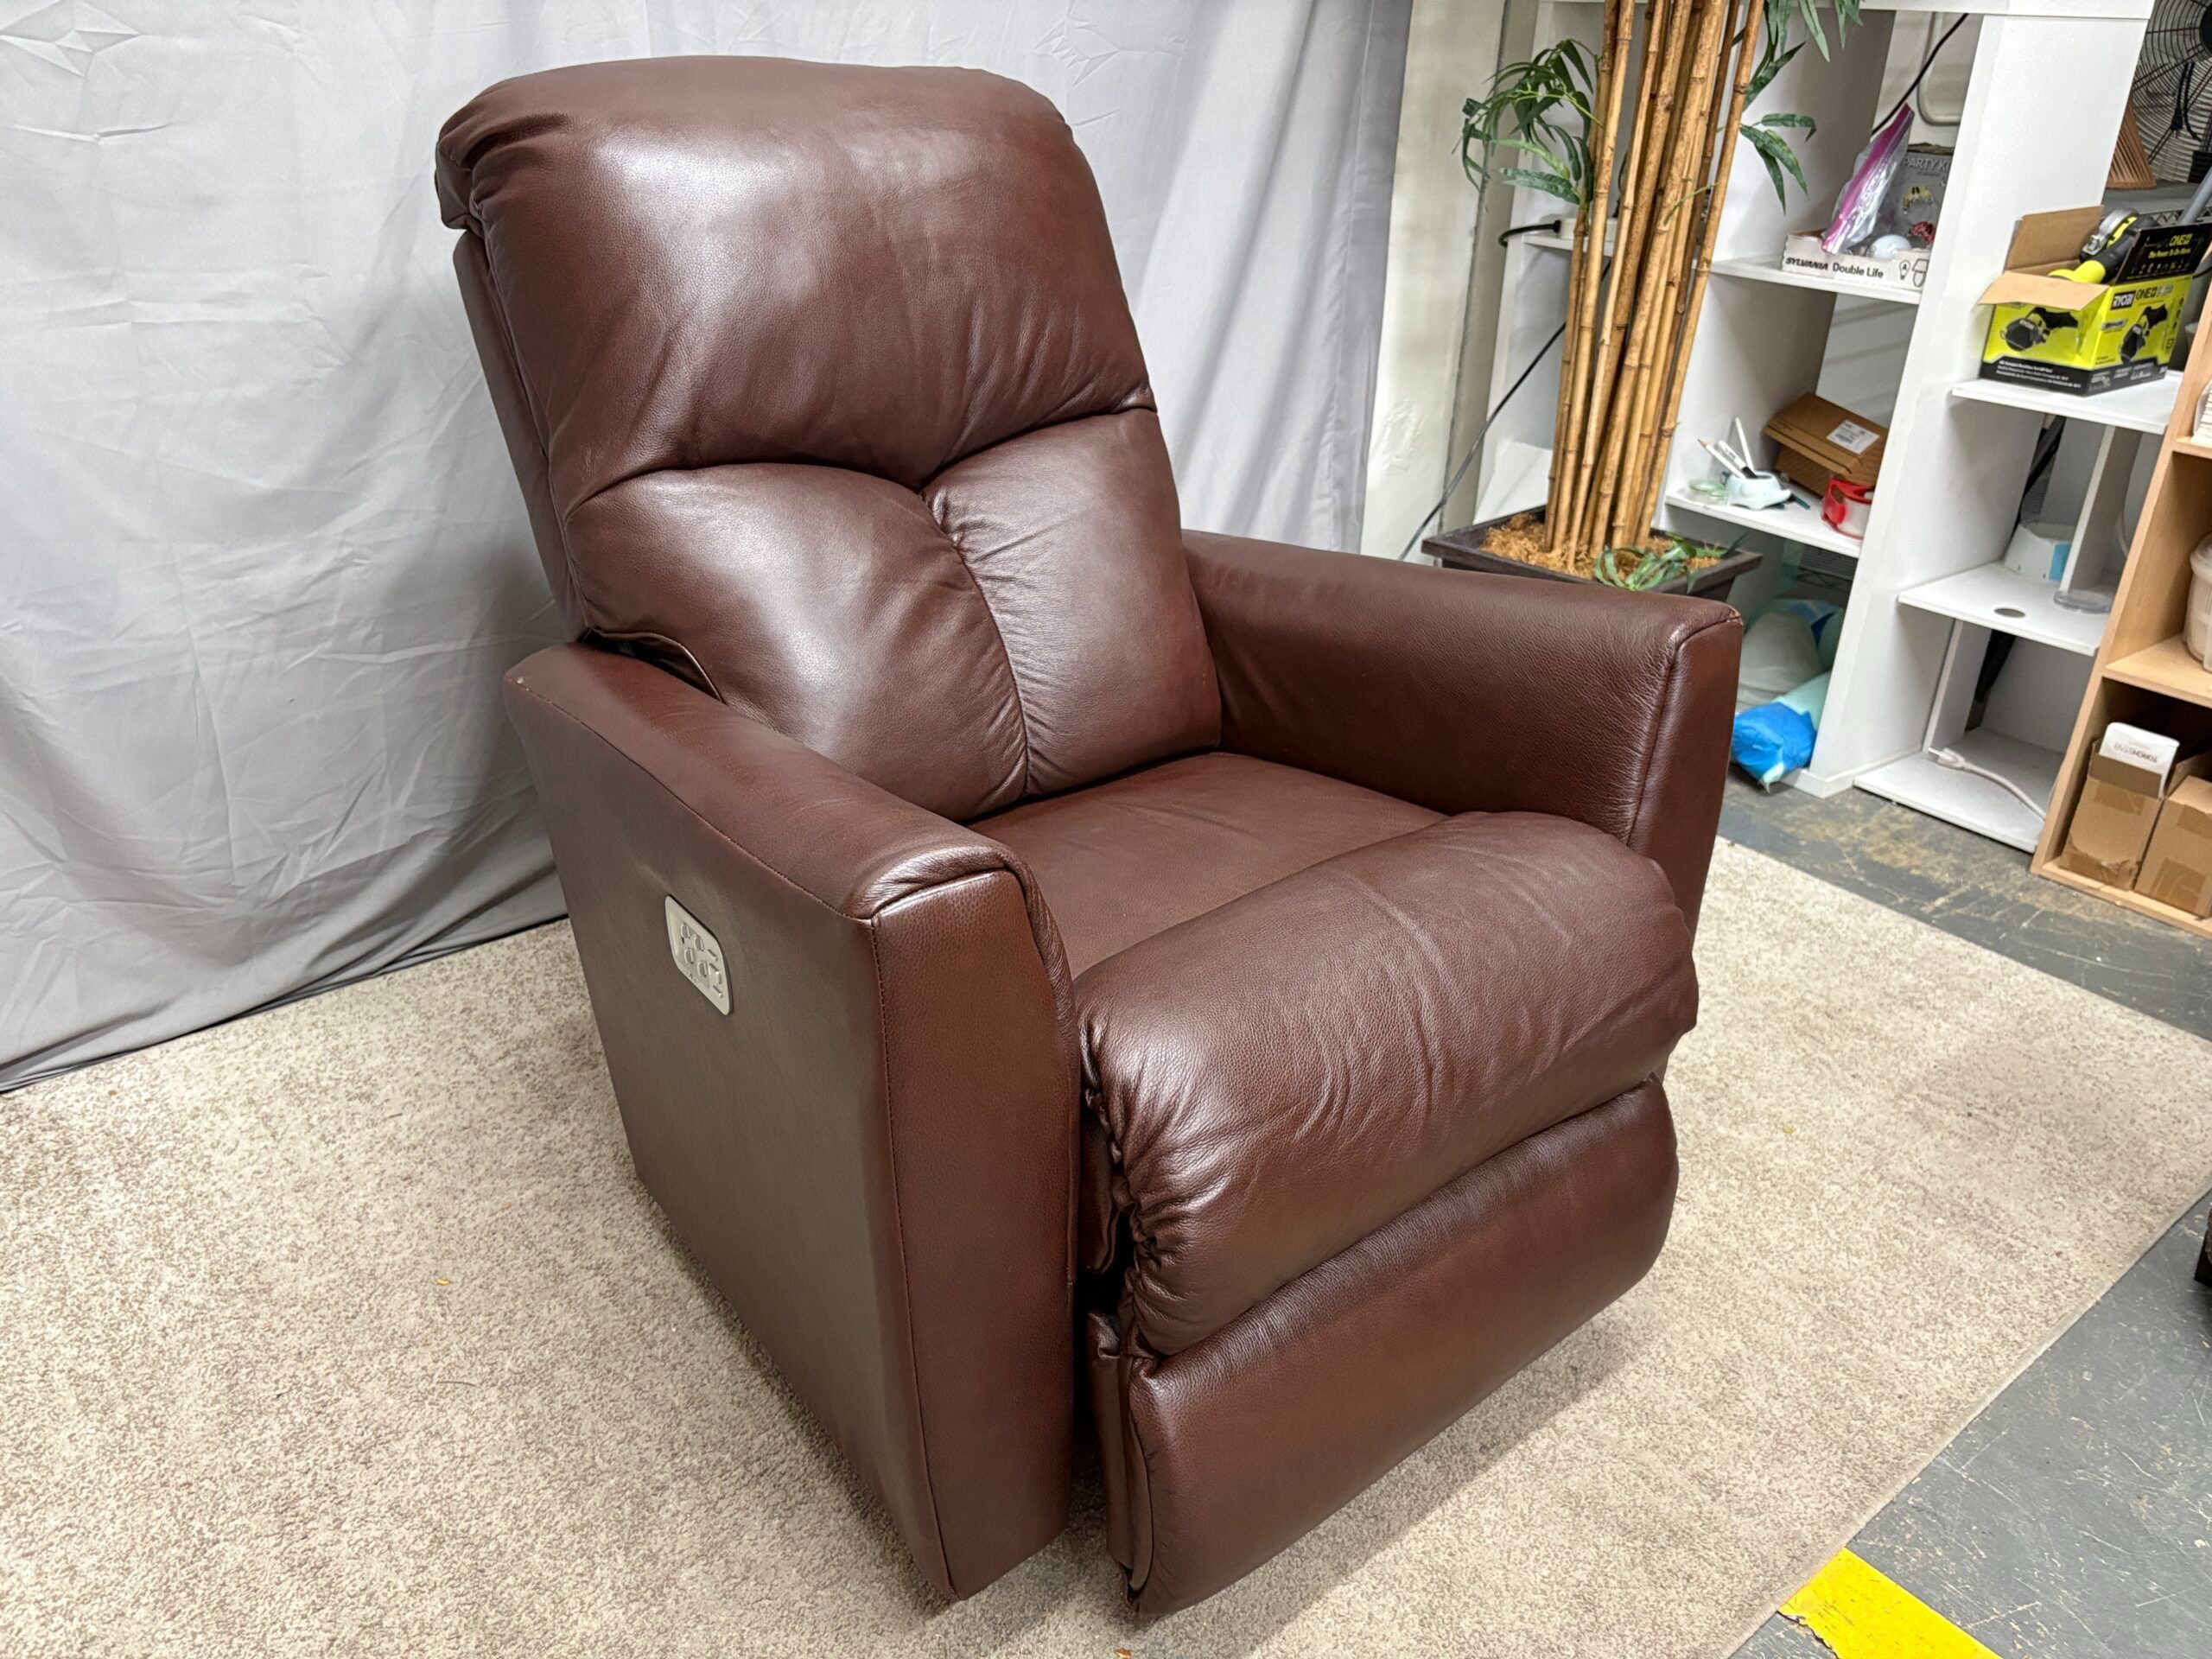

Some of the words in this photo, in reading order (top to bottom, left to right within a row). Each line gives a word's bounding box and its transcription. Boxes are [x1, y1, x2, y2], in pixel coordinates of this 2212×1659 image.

[1904, 156, 1936, 169] PARTY
[1785, 257, 1828, 271] SYLVANIA
[1833, 262, 1865, 276] Double
[1866, 267, 1884, 279] Life
[2112, 293, 2134, 308] RYOBI
